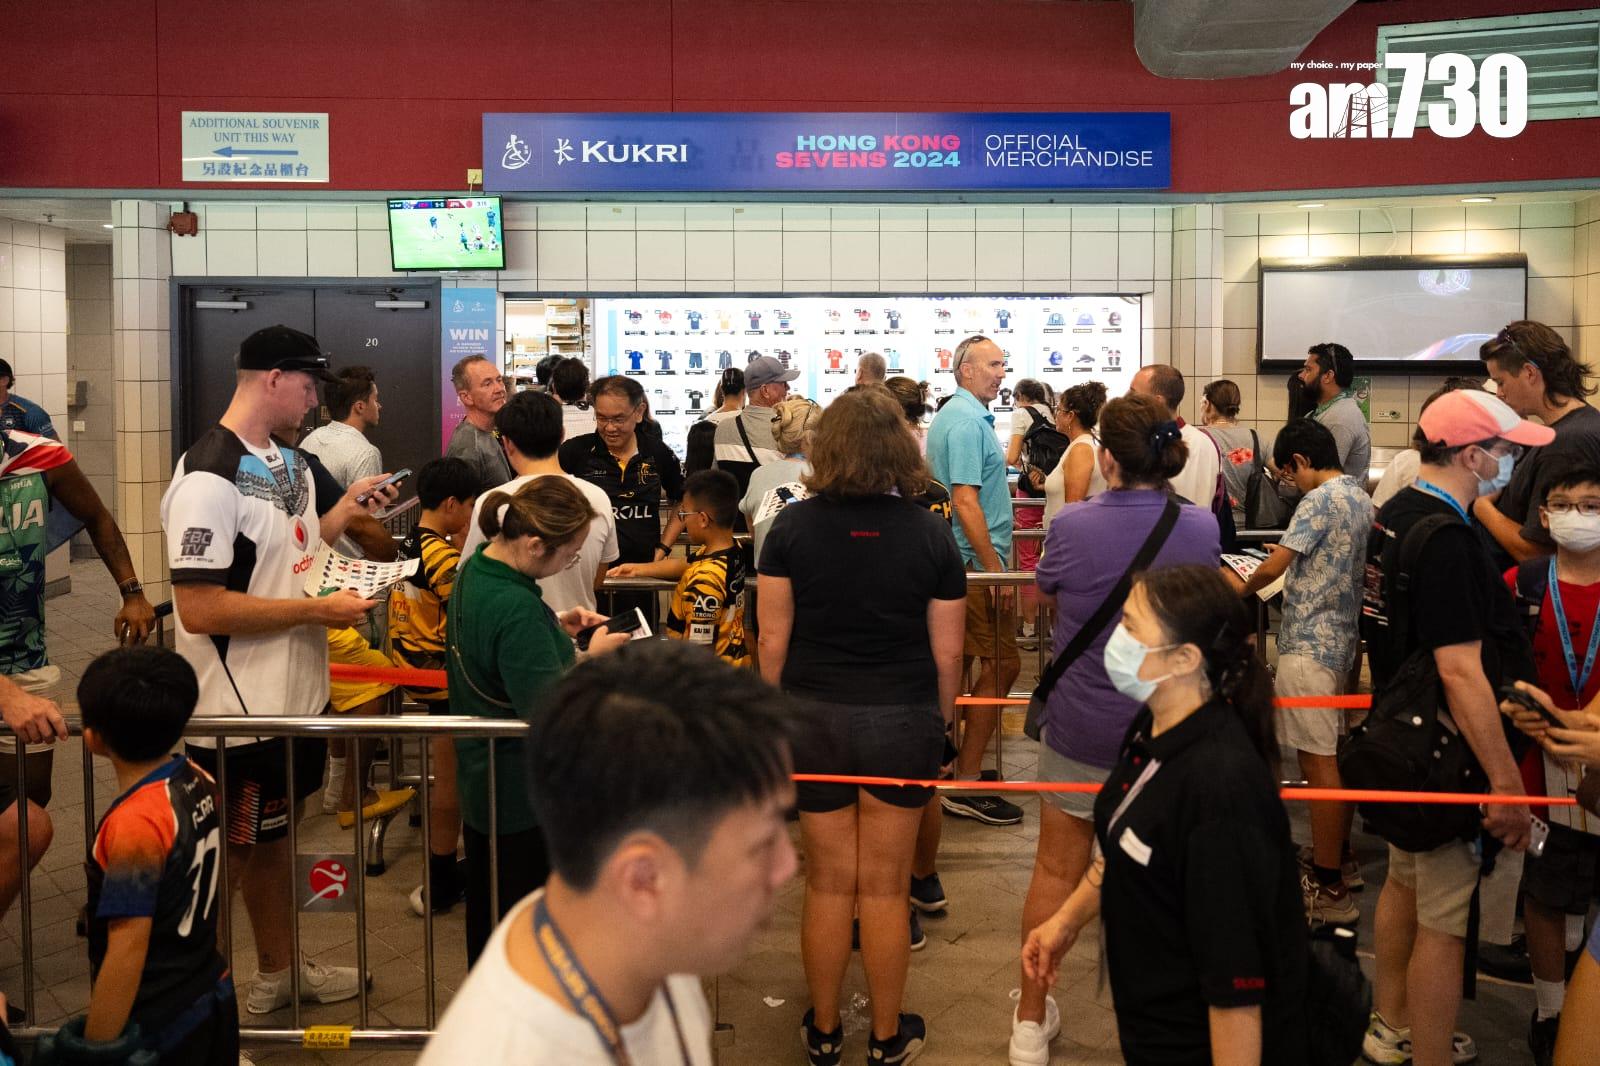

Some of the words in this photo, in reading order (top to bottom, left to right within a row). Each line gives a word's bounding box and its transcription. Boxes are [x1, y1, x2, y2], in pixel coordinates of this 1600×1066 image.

[189, 117, 260, 129] ADDITIONAL
[262, 118, 321, 129] SOUVENIR
[214, 132, 241, 143] UNIT
[244, 132, 269, 143] THIS
[271, 133, 296, 143] WAY
[797, 134, 877, 151] HONG
[883, 134, 961, 151] KONG
[985, 134, 1088, 151] OFFICIAL
[581, 140, 688, 163] KUKRI
[986, 151, 1153, 167] MERCHANDISE
[775, 151, 888, 168] SEVENS
[893, 151, 961, 168] 2024
[202, 162, 309, 177] 另設紀念品櫃台
[365, 337, 379, 347] 20
[449, 328, 489, 341] WIN
